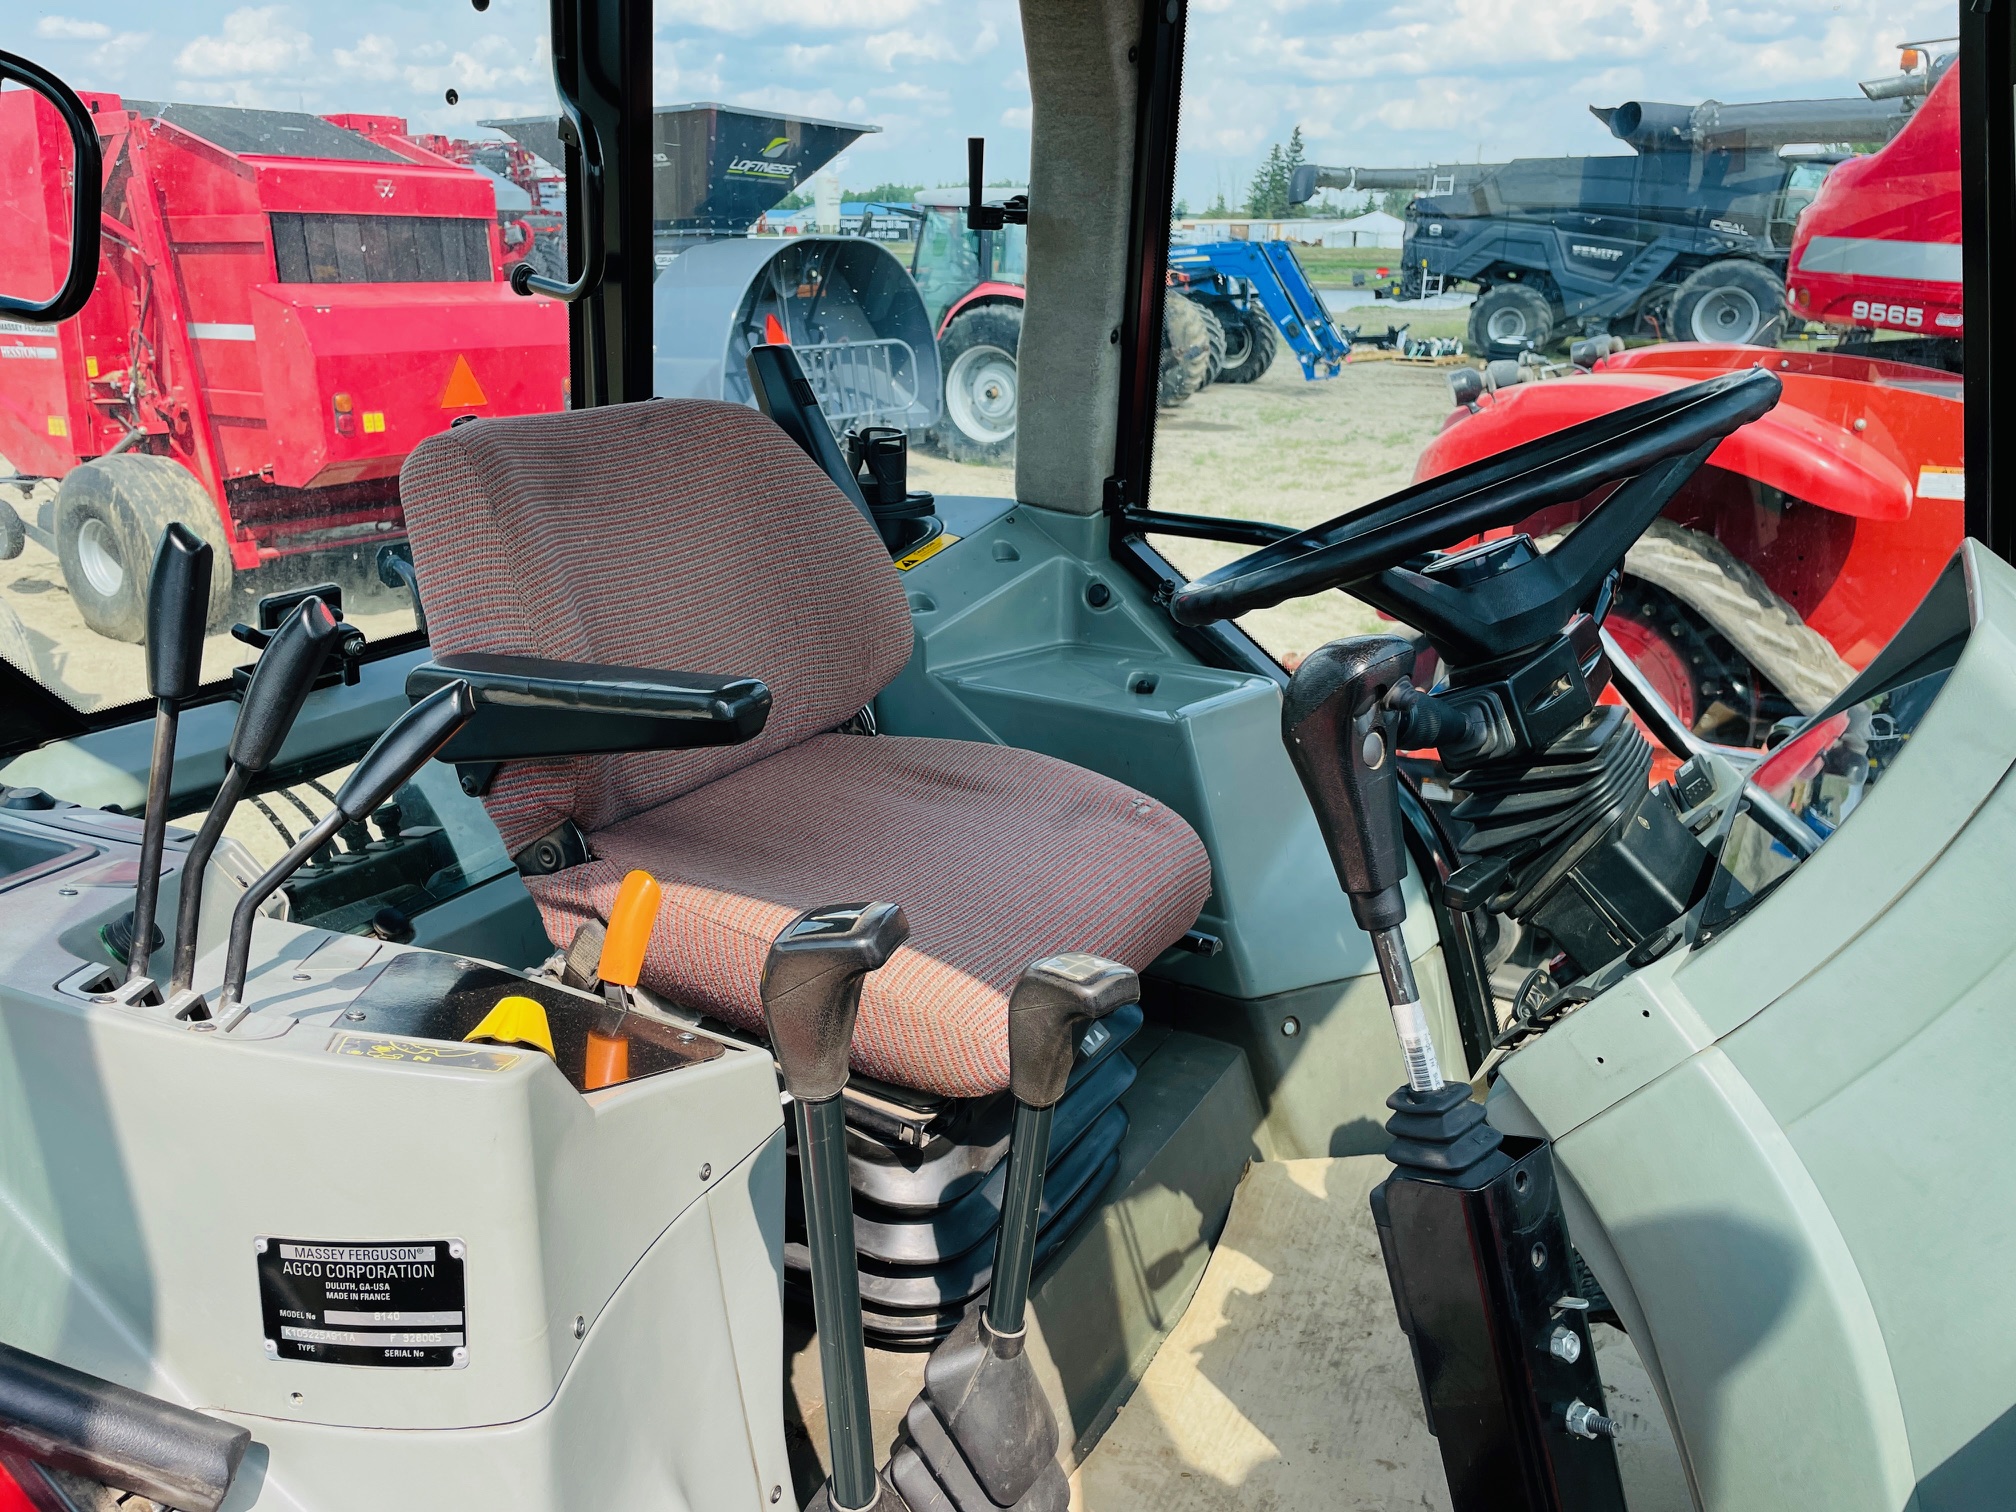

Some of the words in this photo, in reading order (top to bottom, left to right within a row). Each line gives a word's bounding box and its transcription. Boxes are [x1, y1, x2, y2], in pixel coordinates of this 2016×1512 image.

[729, 158, 797, 175] LOFTNESS
[1572, 244, 1623, 261] FENDT
[1852, 300, 1924, 327] 9565
[294, 1247, 344, 1260] MASSEY
[282, 1261, 322, 1277] AGCO
[326, 1263, 435, 1279] CORPORATION
[325, 1281, 358, 1291] DULUTH,
[359, 1282, 390, 1291] GA-USA
[326, 1291, 349, 1300] MADE
[350, 1291, 358, 1300] IN
[360, 1292, 391, 1301] FRANCE
[279, 1309, 305, 1319] MODEL
[374, 1311, 400, 1321] 8140
[390, 1333, 396, 1342] F
[297, 1343, 316, 1352] TYPE
[384, 1349, 411, 1357] SERIAL
